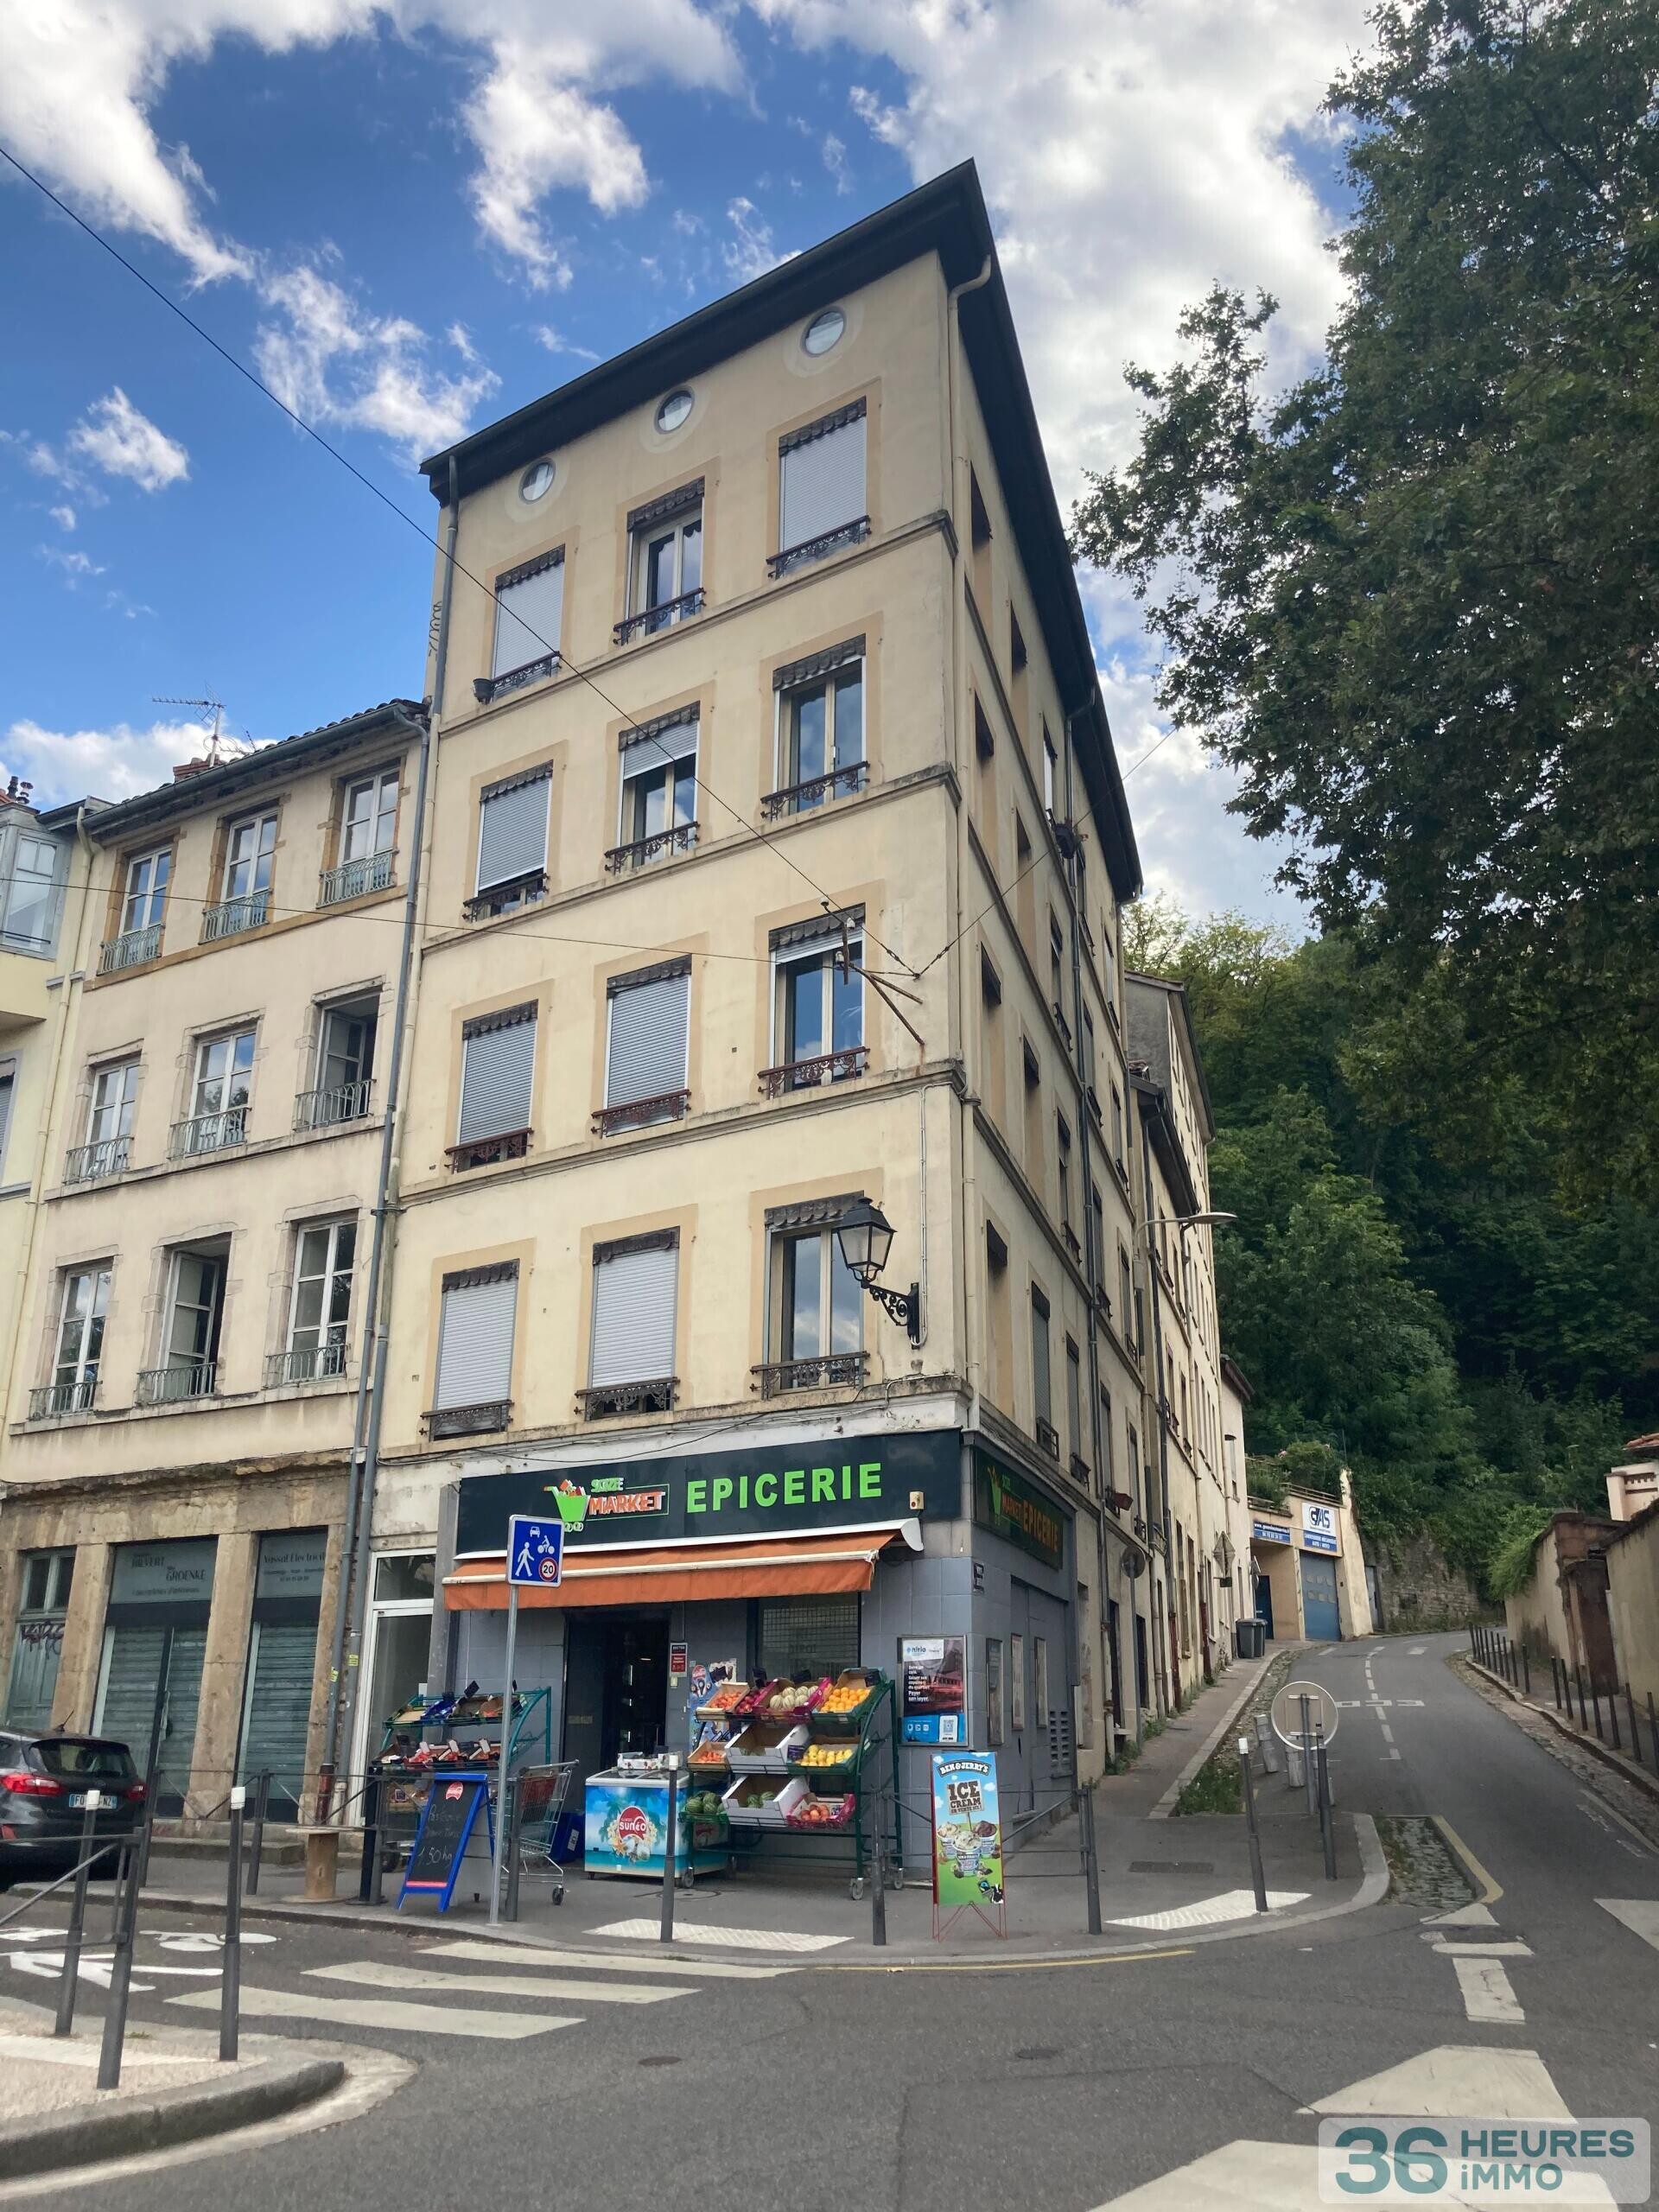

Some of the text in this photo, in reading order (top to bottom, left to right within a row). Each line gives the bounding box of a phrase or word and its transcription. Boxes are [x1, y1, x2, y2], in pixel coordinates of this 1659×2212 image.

[687, 1462, 883, 1514] EPICERIE
[589, 1491, 665, 1516] MARKET
[1023, 1499, 1058, 1553] EPICERIE
[543, 1565, 554, 1574] 20
[947, 1780, 981, 1801] ICE
[950, 1796, 982, 1809] CREAM
